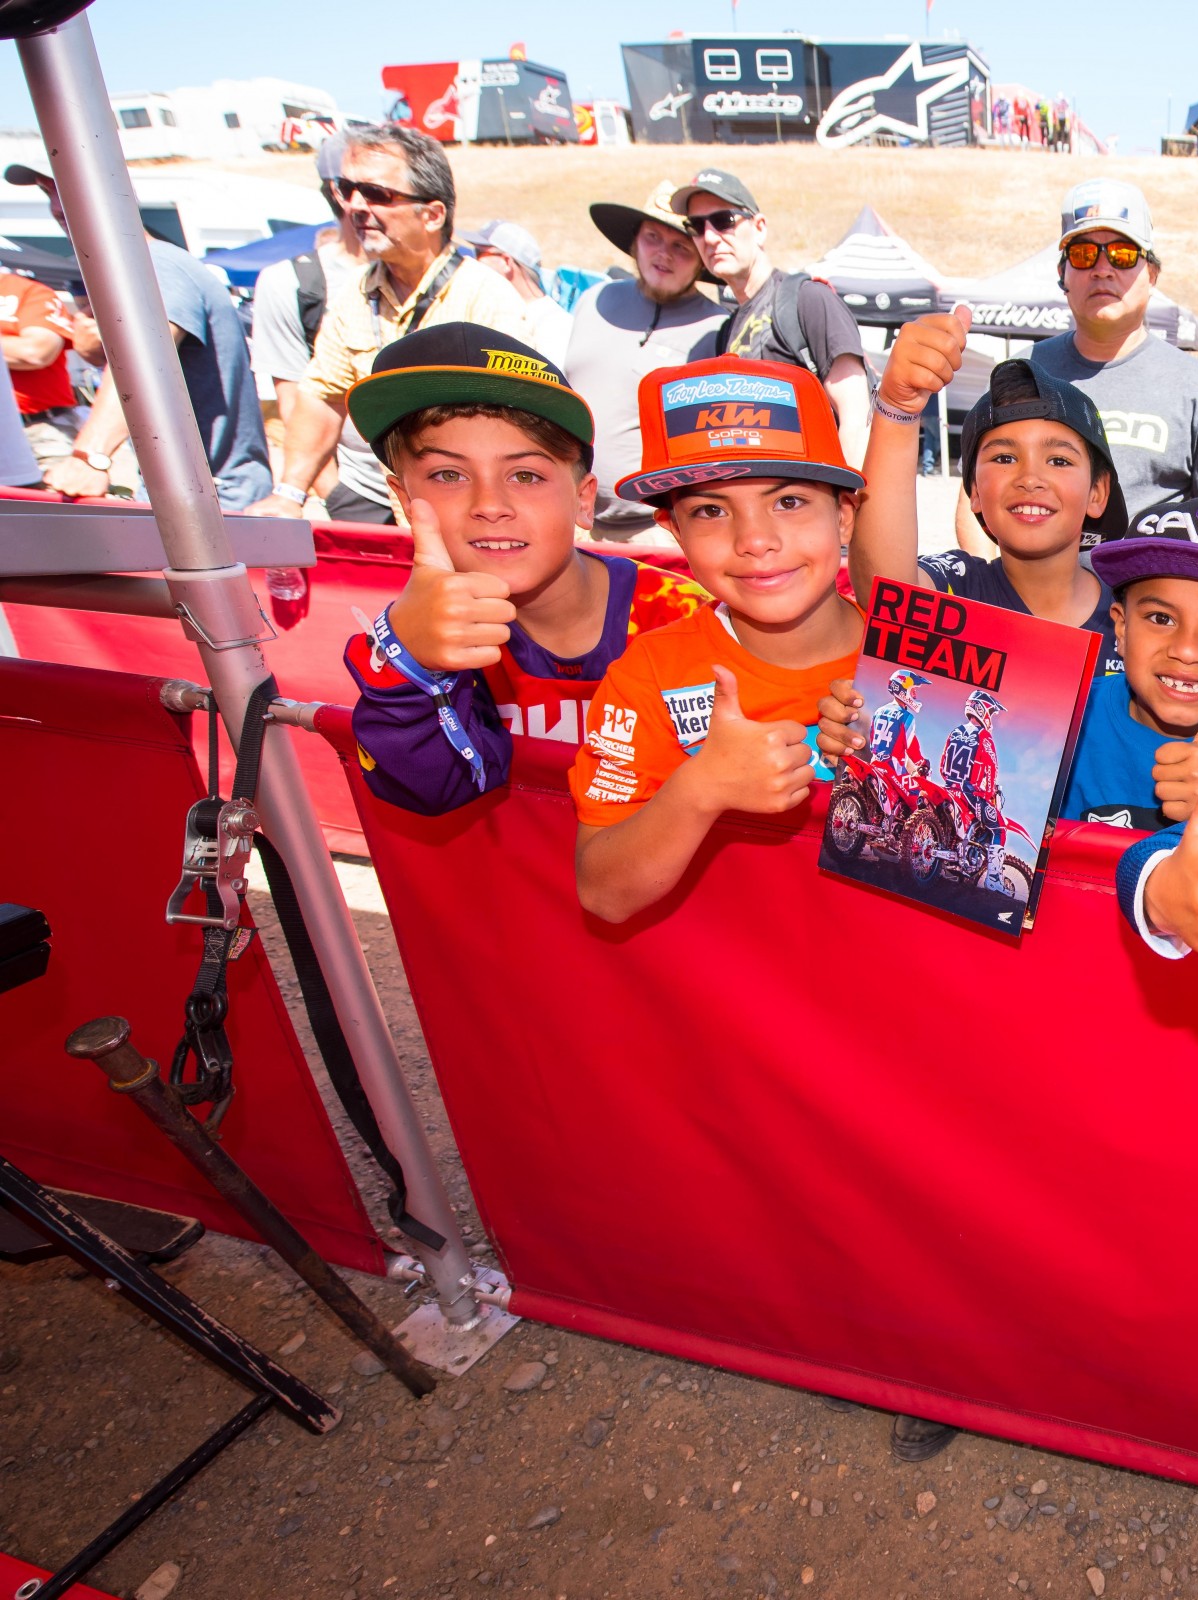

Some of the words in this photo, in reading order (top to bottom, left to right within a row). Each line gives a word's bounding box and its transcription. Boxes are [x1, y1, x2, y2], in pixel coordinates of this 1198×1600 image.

[949, 299, 1072, 330] STHOUSE
[667, 383, 698, 404] Troy
[696, 381, 725, 399] Lee
[726, 378, 791, 400] Designs
[695, 402, 771, 430] KTM
[708, 430, 761, 439] GoPro
[873, 581, 968, 637] RED
[870, 620, 1004, 690] TEAM
[602, 708, 636, 733] PPG
[944, 743, 973, 780] 14
